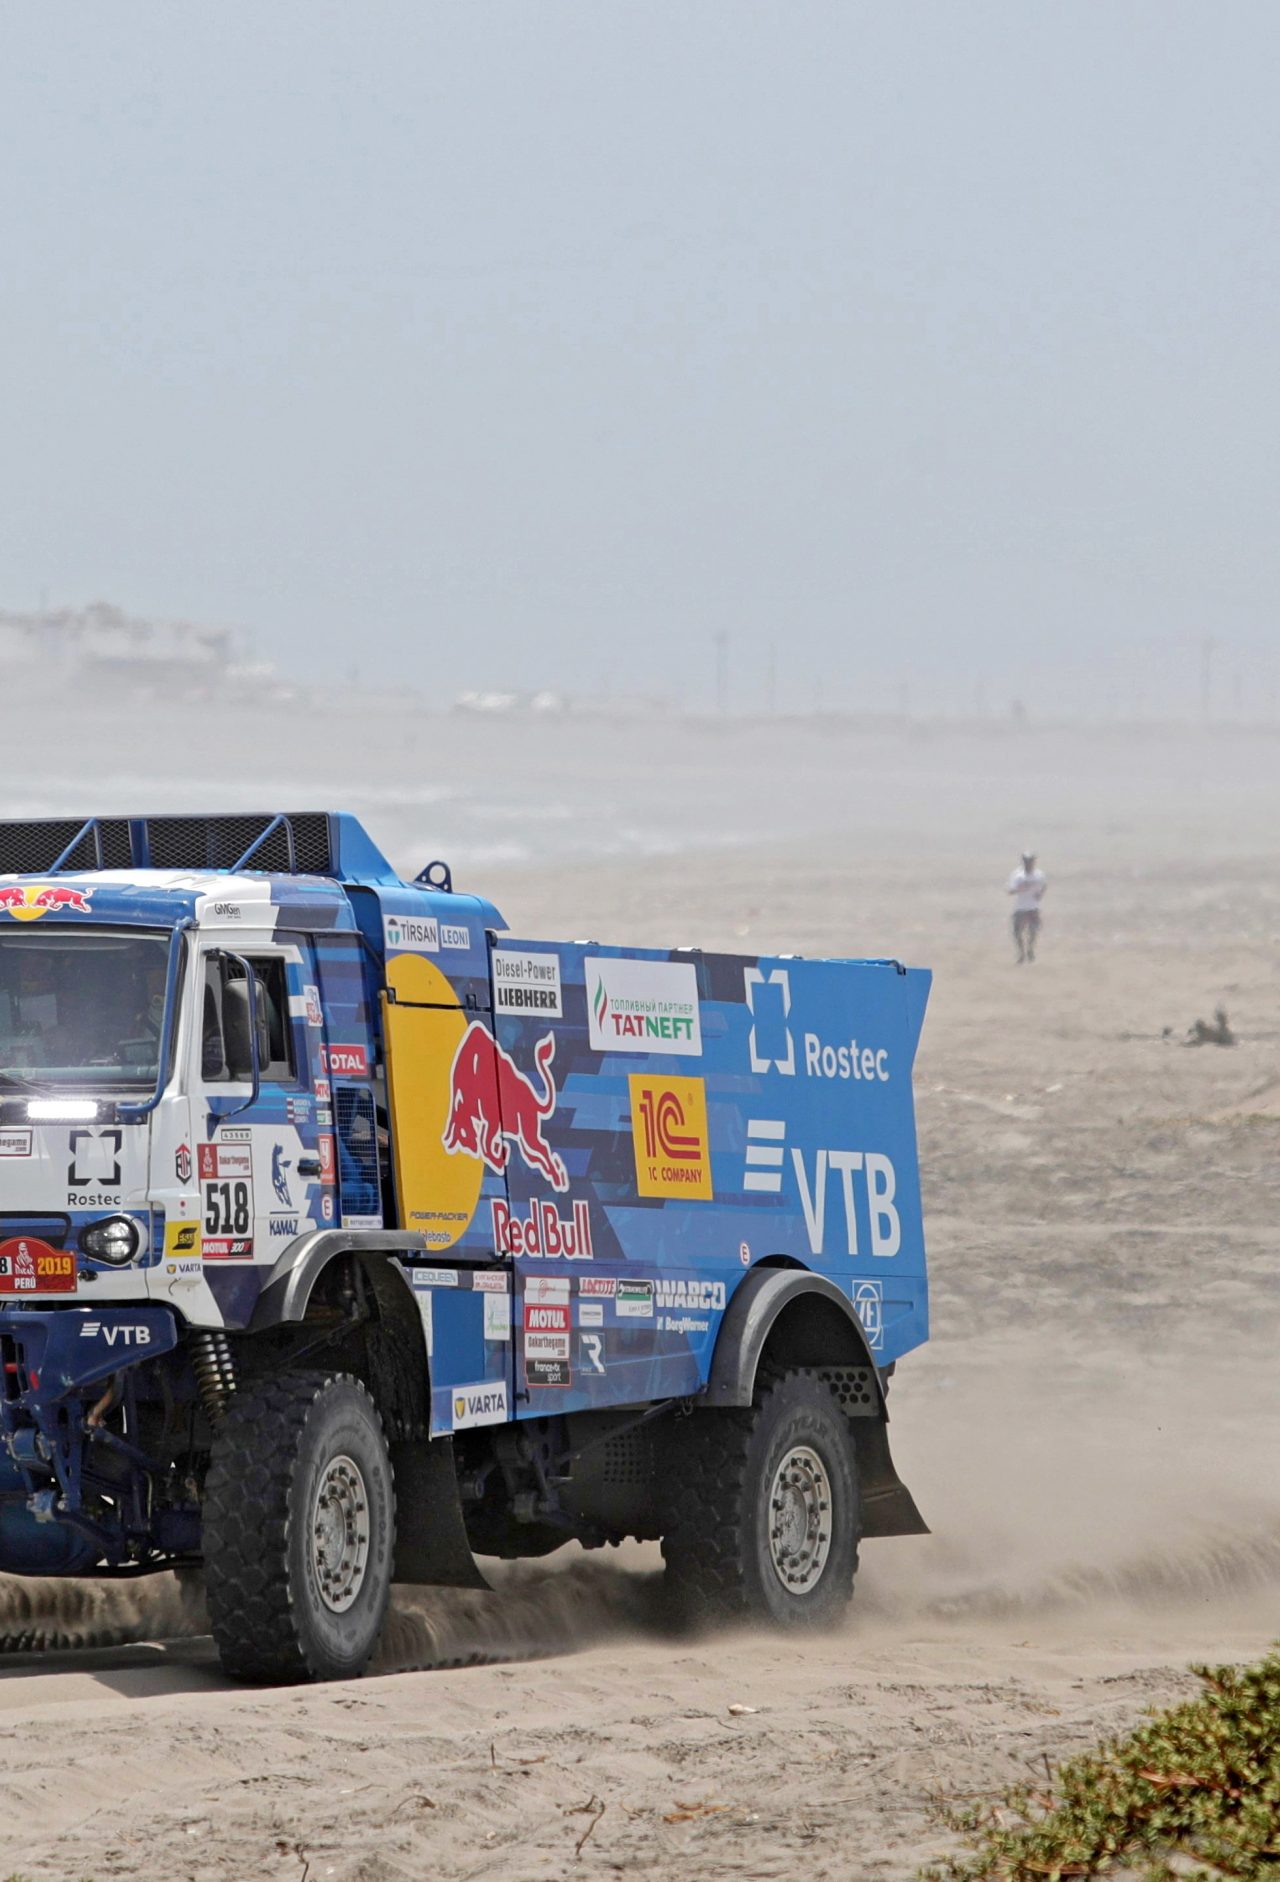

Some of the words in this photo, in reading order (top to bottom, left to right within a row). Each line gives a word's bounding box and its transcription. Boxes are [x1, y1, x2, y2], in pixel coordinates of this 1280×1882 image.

[441, 930, 469, 946] LEONI
[495, 958, 556, 981] Diesel-Power
[498, 987, 559, 1009] LIEBHERR
[610, 998, 656, 1013] ТОПЛИВНЫЙ
[658, 1002, 694, 1015] ПАРТНЕР
[611, 1013, 694, 1041] TATNEFT
[321, 1049, 365, 1070] TOTAL
[804, 1032, 890, 1082] Rostec
[648, 1166, 658, 1182] 1C
[661, 1167, 702, 1184] COMPANY
[67, 1192, 121, 1206] Rostec
[205, 1181, 250, 1236] 518
[791, 1148, 902, 1257] VTB
[269, 1219, 298, 1236] KAMAZ
[491, 1197, 542, 1258] Red
[541, 1199, 594, 1259] Bull
[203, 1242, 229, 1254] MOTUL
[37, 1257, 72, 1275] 2019
[179, 1263, 201, 1273] VARTA
[14, 1275, 36, 1289] PERÚ
[656, 1279, 726, 1311] WABCO
[528, 1309, 566, 1329] MOTUL
[665, 1316, 709, 1335] BorgWarner
[102, 1325, 151, 1346] VTB
[528, 1335, 566, 1349] Dakarthegame
[468, 1393, 505, 1415] VARTA
